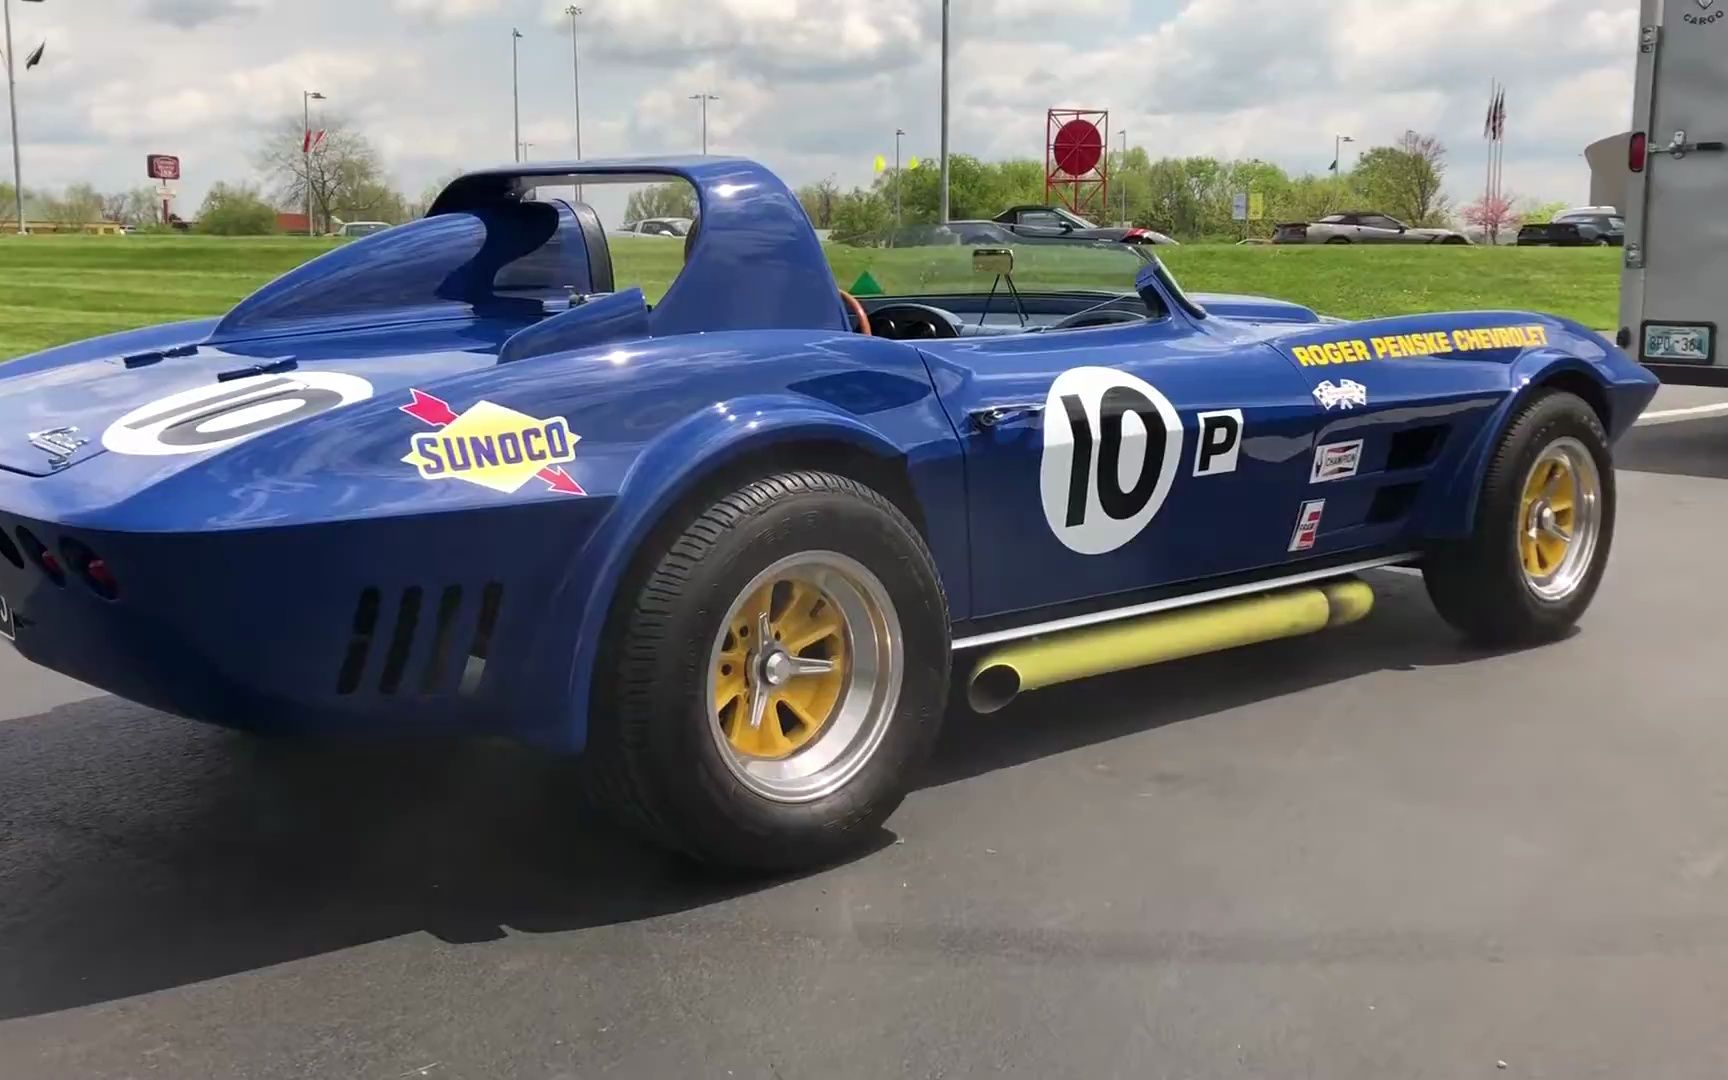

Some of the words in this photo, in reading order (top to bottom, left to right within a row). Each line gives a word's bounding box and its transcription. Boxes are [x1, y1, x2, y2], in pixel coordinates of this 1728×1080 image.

[1683, 10, 1724, 25] CARGO
[1292, 340, 1371, 366] ROGER
[1370, 331, 1453, 359] PENSKE
[1453, 326, 1547, 351] CHEVROLET
[123, 377, 343, 446] 10
[417, 421, 570, 475] SUNOCO
[1060, 386, 1167, 527] 10
[1198, 415, 1239, 471] P
[1325, 452, 1356, 467] CHAMPION
